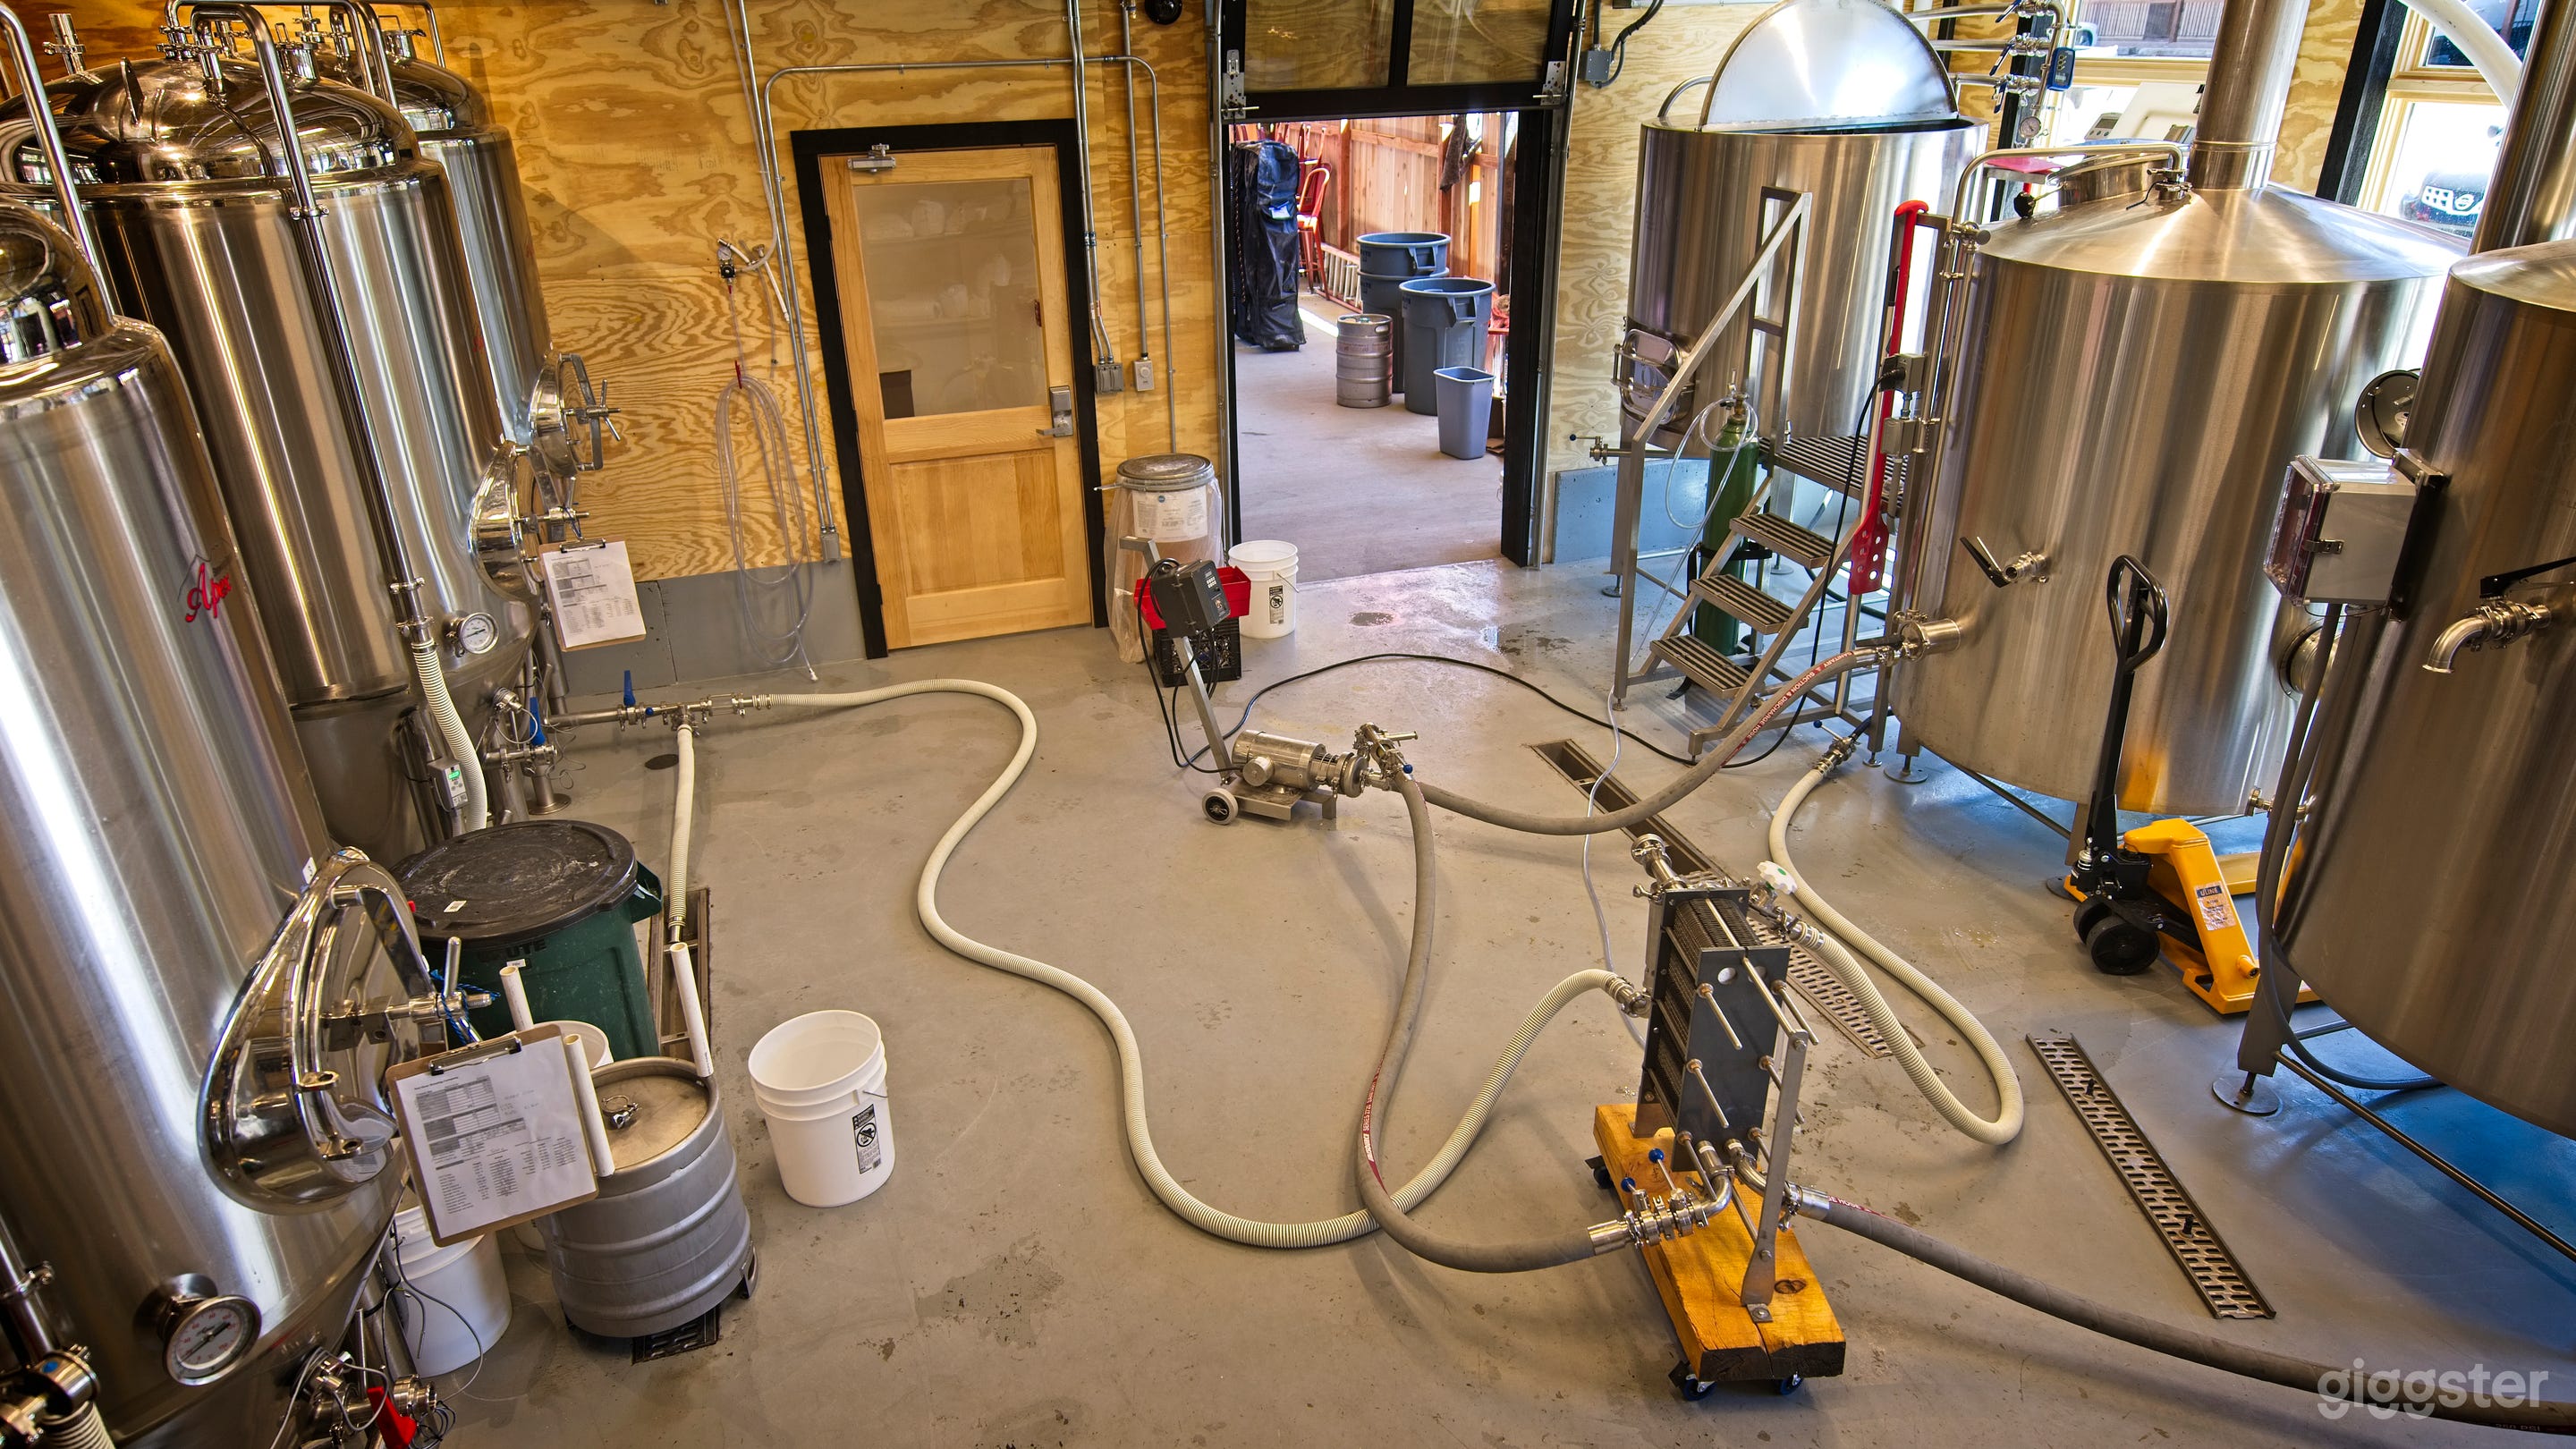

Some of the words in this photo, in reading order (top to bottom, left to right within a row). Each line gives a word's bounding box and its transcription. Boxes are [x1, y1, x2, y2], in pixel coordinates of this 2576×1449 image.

[185, 562, 232, 623] Apex
[1824, 651, 1853, 667] SANITARY
[1791, 671, 1816, 693] SUCTION
[1760, 696, 1788, 725] DISCHARGE
[1748, 724, 1762, 739] HOSE
[2200, 887, 2219, 897] ULINE
